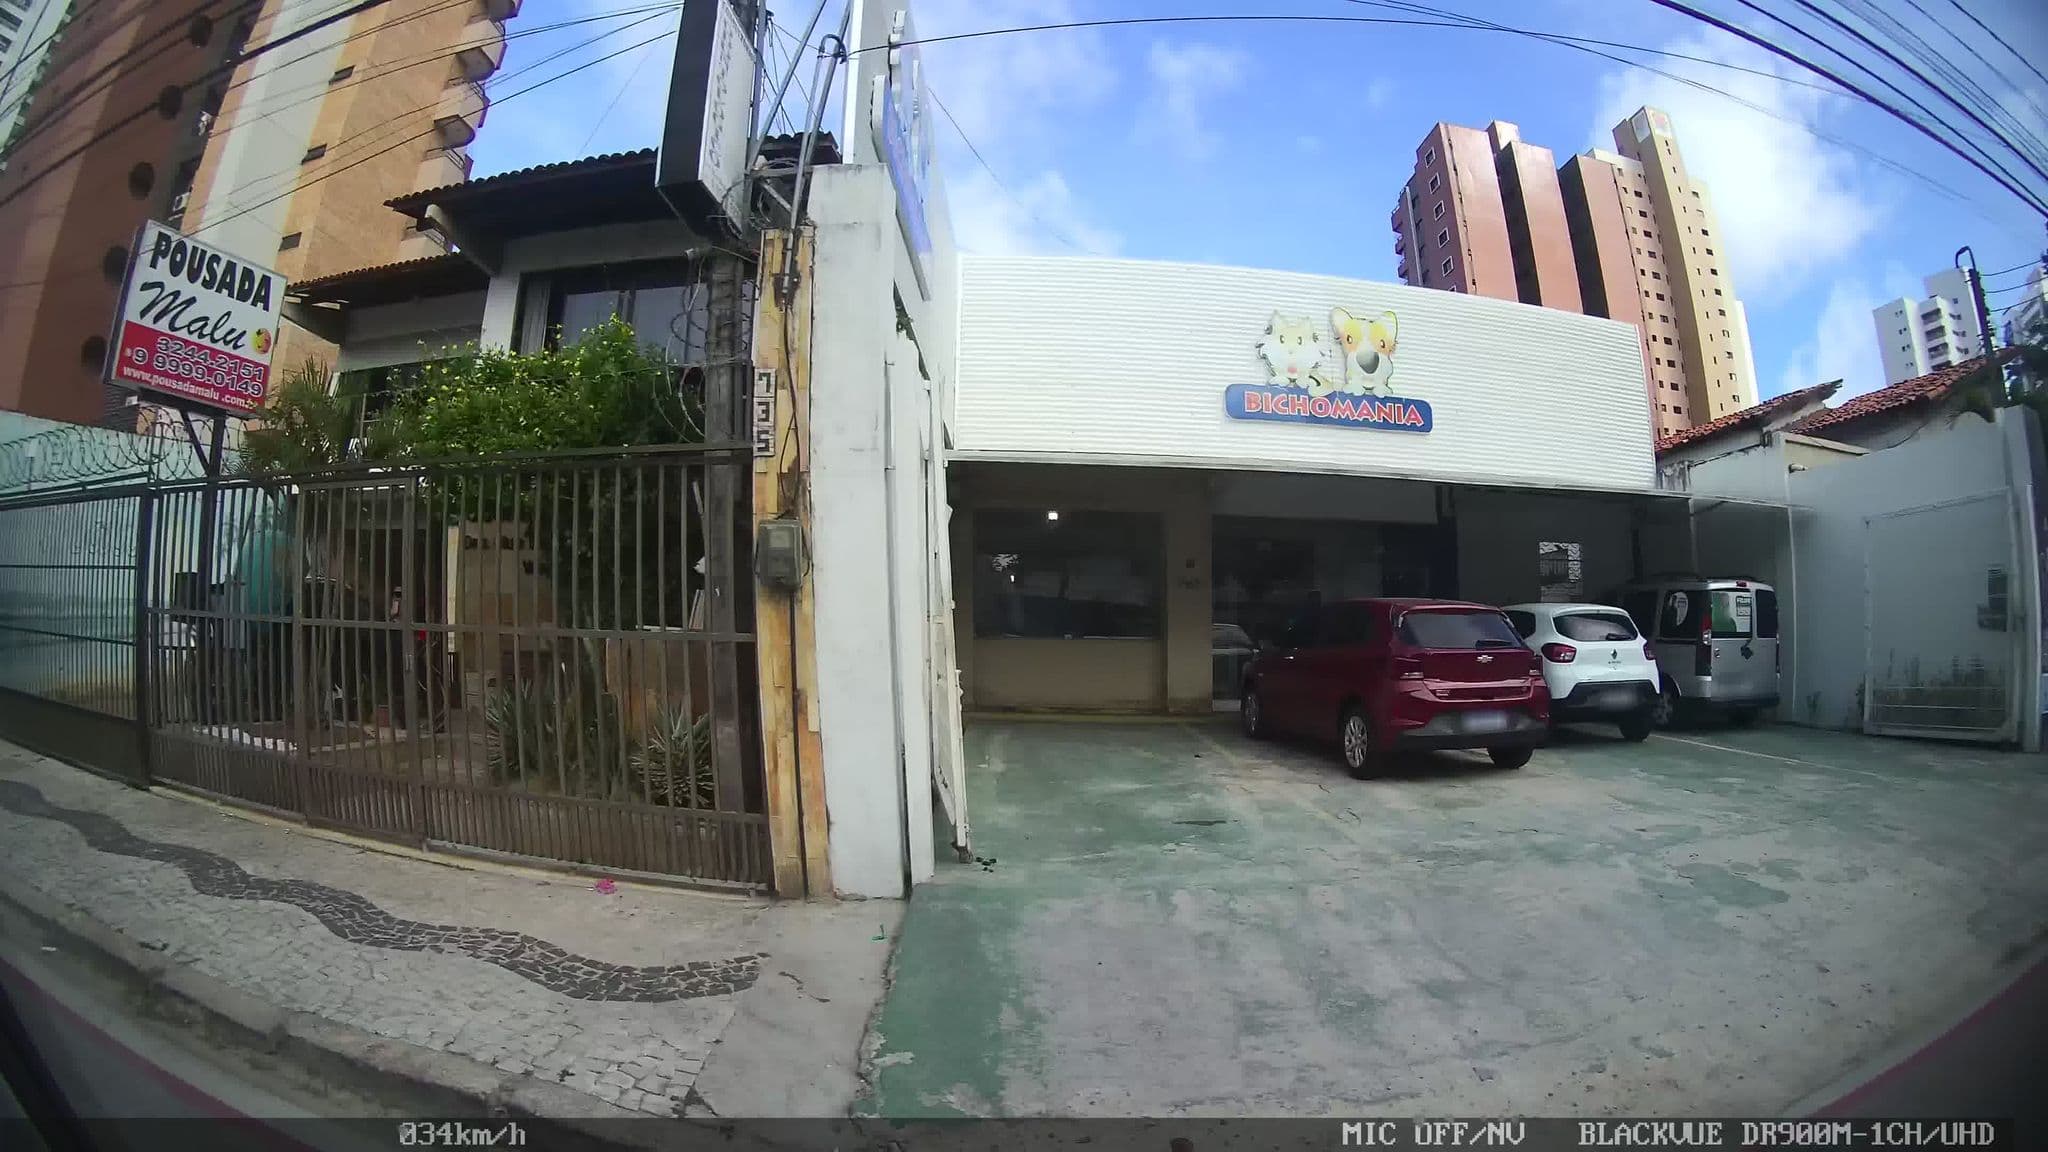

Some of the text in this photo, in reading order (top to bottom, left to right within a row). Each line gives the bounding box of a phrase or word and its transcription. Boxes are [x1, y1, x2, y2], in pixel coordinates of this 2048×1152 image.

[150, 231, 272, 312] POUSADA
[139, 281, 247, 350] Malu
[155, 337, 265, 382] 3244.2151
[756, 371, 772, 453] 735
[1243, 391, 1424, 426] BICHOMANIA
